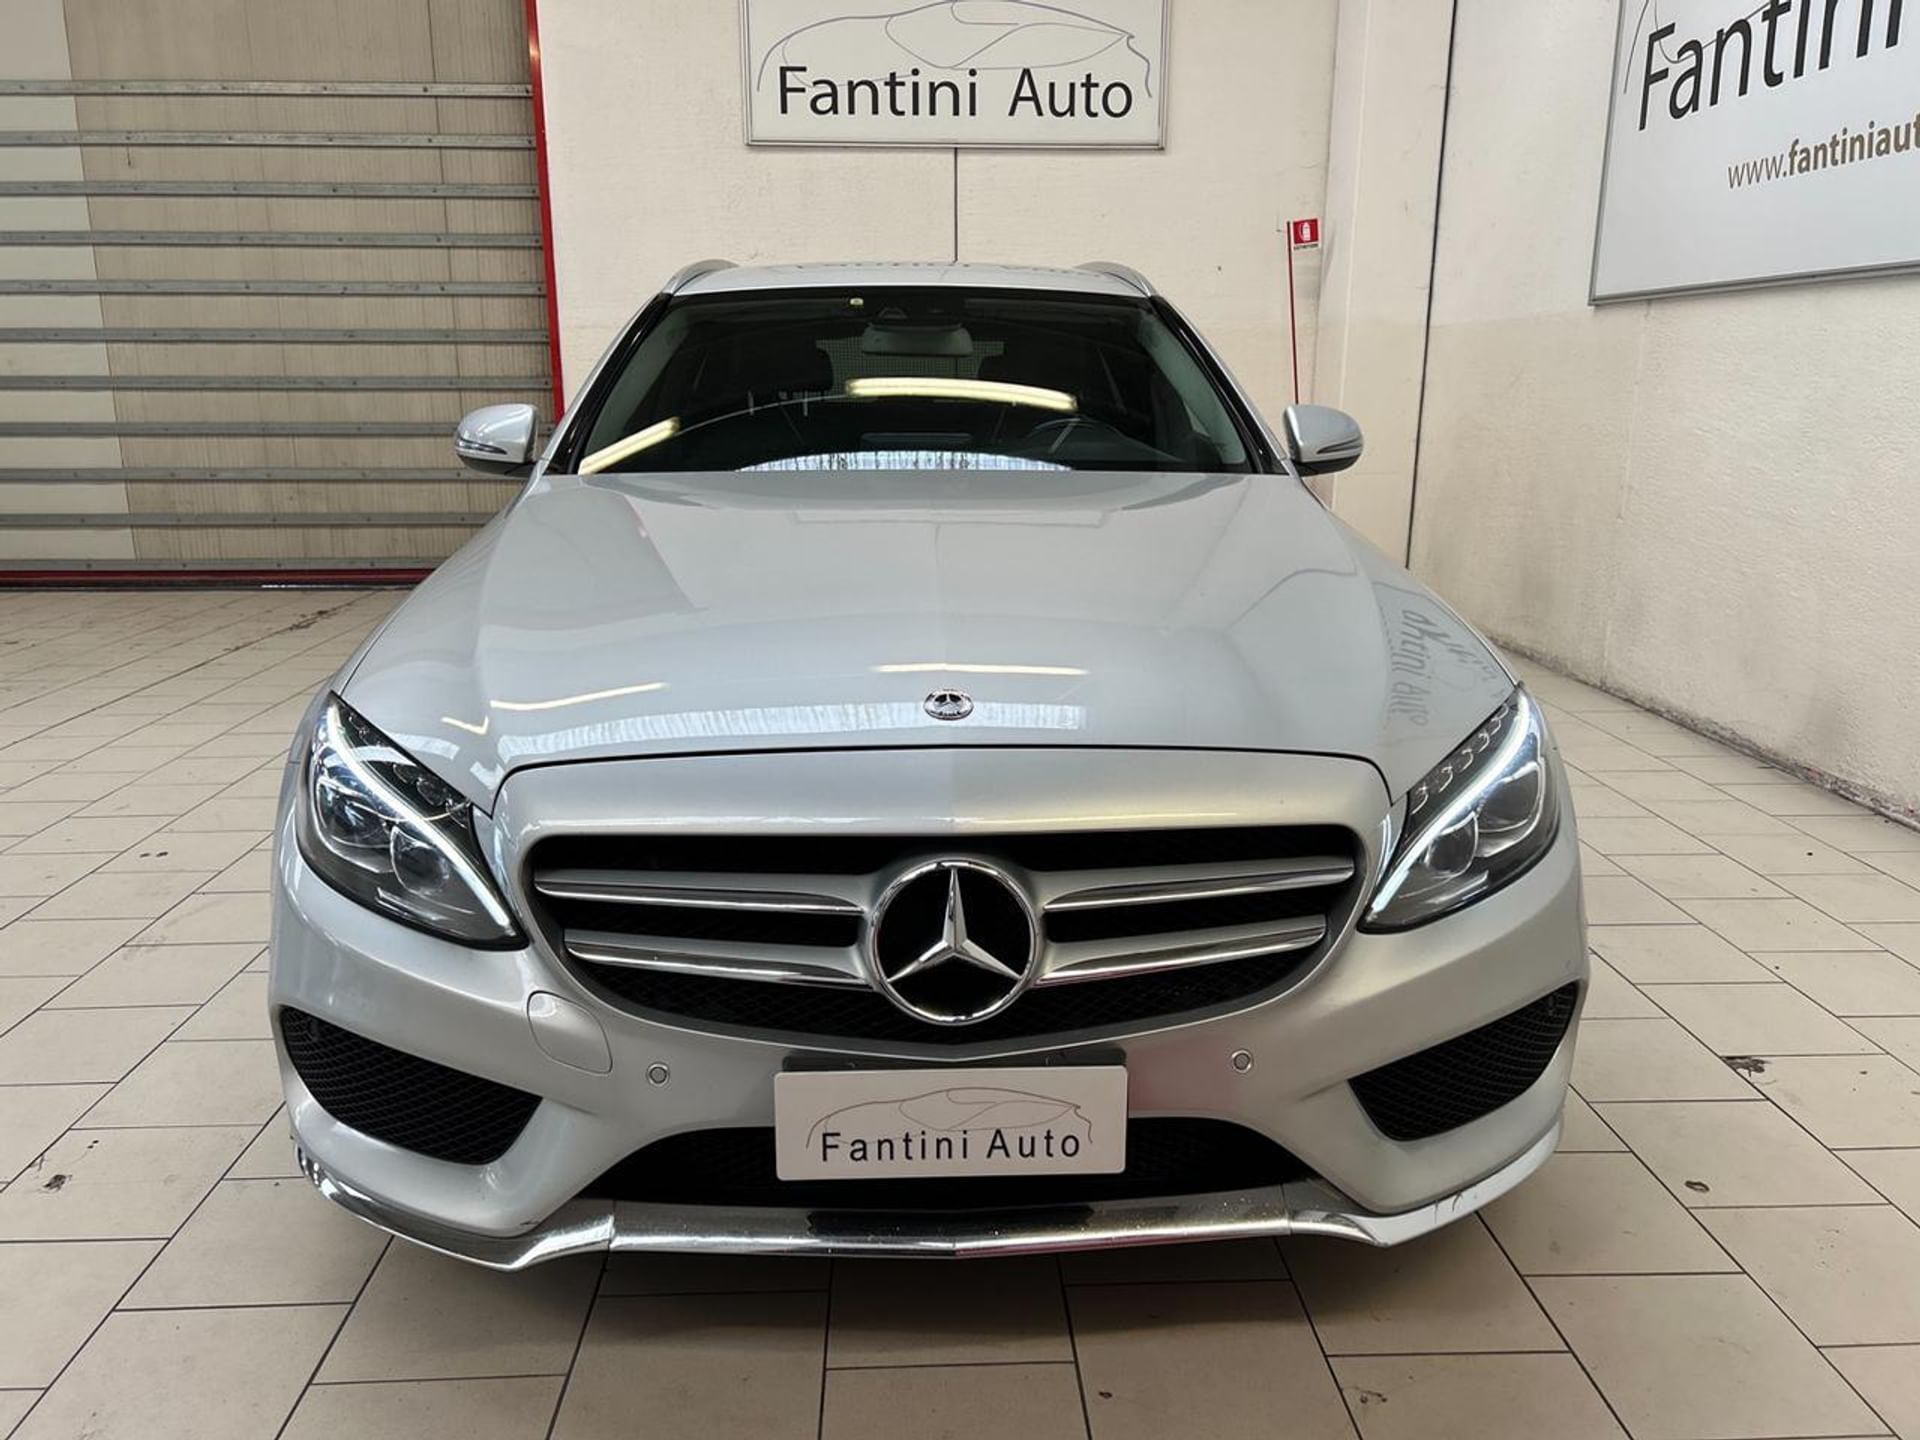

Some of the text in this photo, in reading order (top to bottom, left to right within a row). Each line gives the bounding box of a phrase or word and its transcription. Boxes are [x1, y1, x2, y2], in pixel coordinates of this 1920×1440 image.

[779, 66, 1133, 117] Fantini Auto
[821, 1128, 1081, 1162] Fantini Auto
